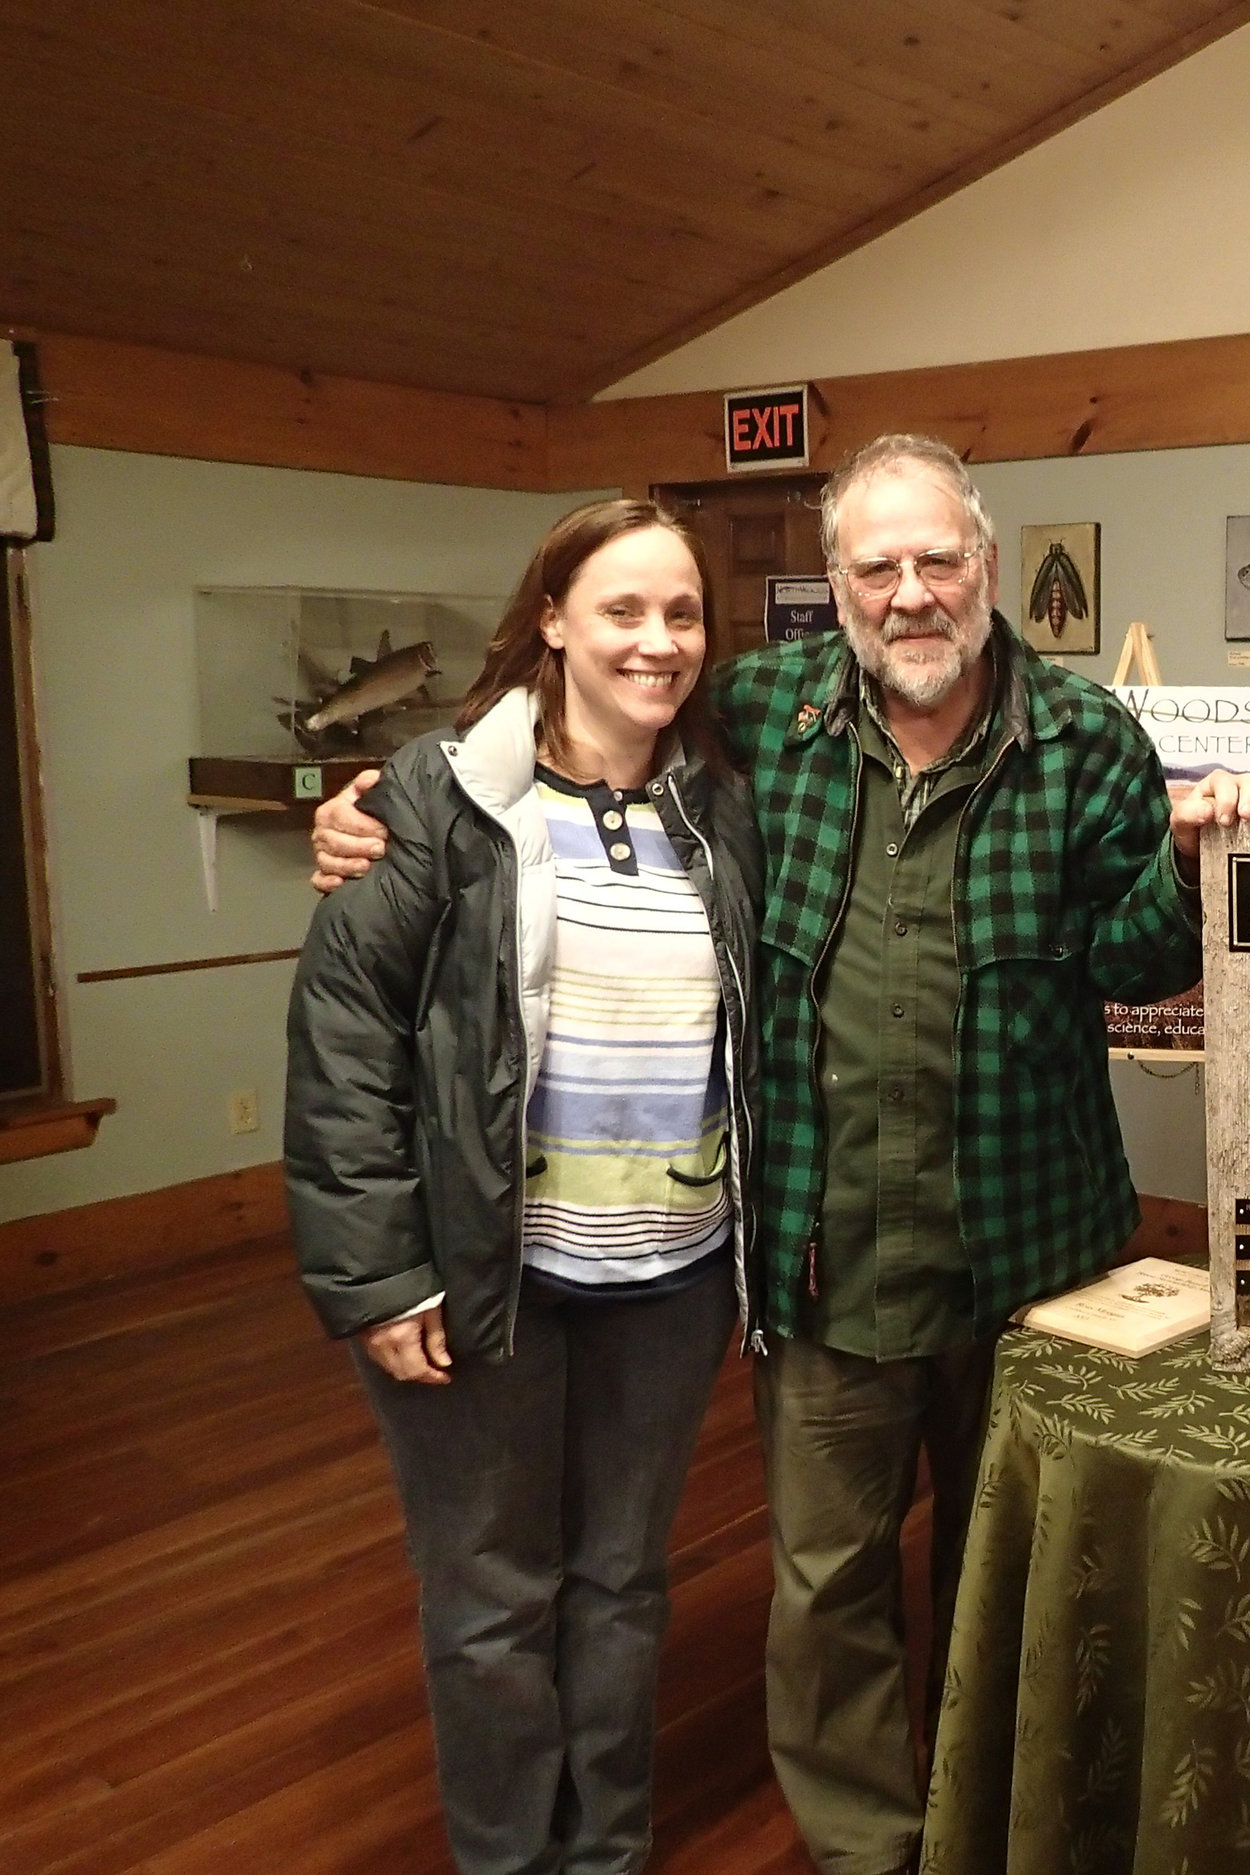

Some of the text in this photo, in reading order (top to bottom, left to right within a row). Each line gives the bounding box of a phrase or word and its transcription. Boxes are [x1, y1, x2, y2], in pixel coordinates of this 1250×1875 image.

[733, 404, 799, 451] EXIT
[790, 610, 813, 623] Staff
[785, 628, 812, 640] Offi
[302, 773, 317, 791] C
[1114, 1003, 1129, 1015] to
[1131, 1004, 1204, 1022] appreciate
[1107, 1019, 1205, 1036] science, educa
